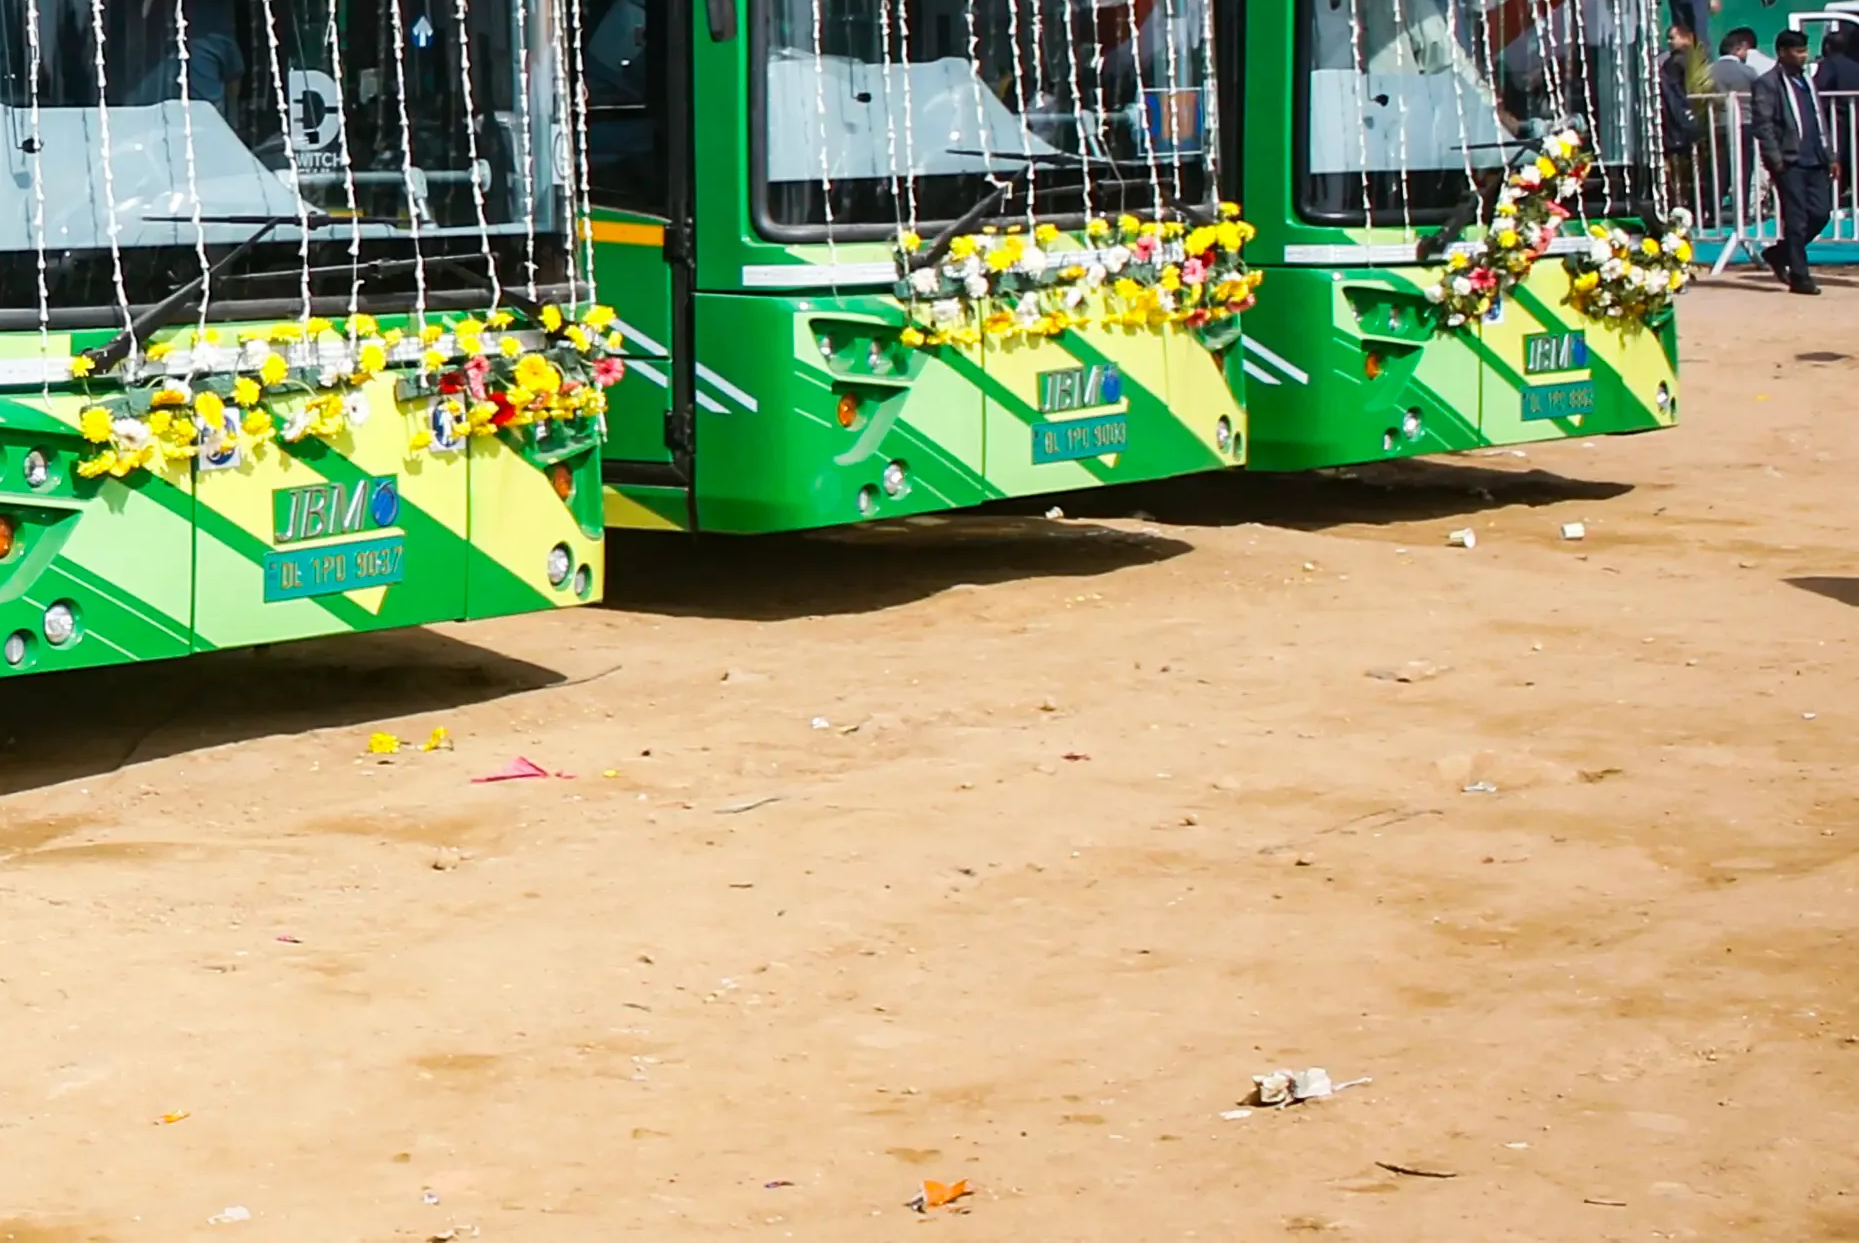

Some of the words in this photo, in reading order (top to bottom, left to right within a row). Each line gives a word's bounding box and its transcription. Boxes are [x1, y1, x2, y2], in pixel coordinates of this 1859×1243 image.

[294, 152, 342, 167] WITCH
[1038, 365, 1102, 414] JBM
[276, 480, 368, 542] JBM
[281, 560, 303, 589] DL
[312, 554, 346, 585] 1PD
